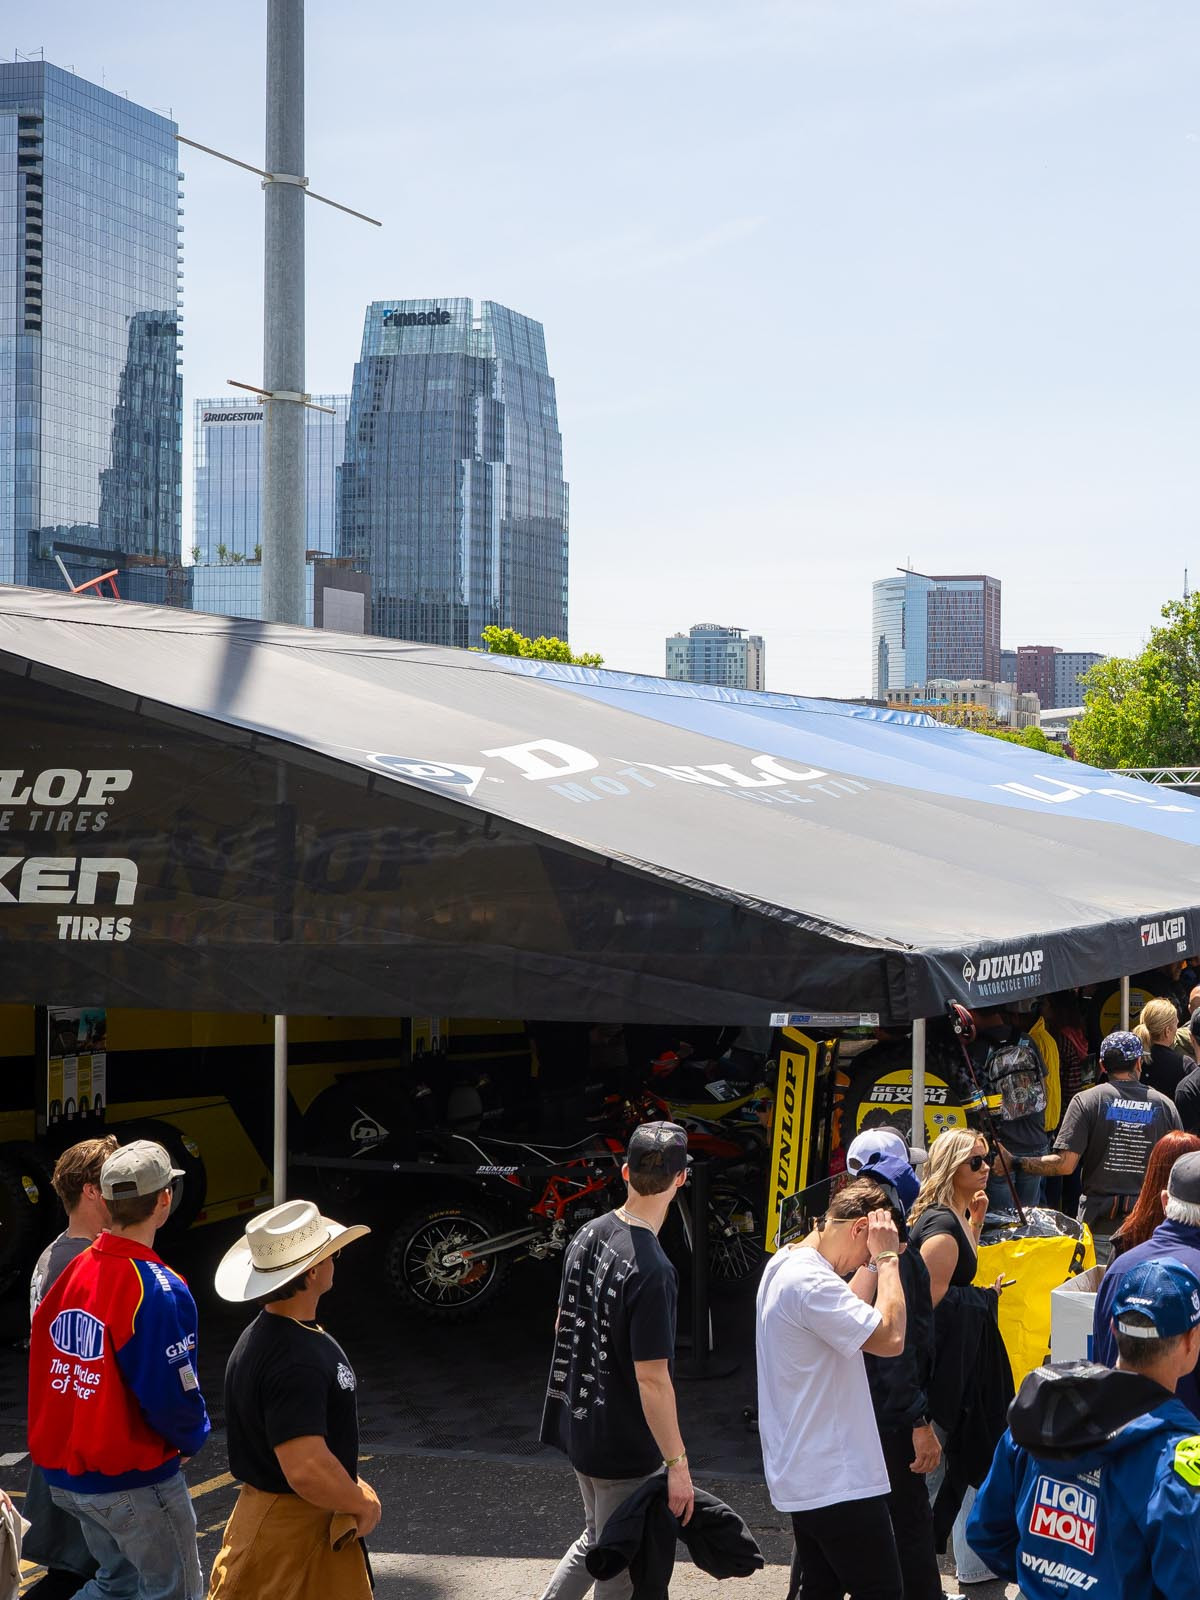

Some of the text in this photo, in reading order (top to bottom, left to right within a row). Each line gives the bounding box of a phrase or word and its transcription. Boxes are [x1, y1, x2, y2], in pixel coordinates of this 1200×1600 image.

[383, 307, 451, 327] Pinnacle
[29, 811, 109, 832] TIRES
[56, 915, 132, 942] TIRES
[1140, 916, 1186, 947] FALKEN
[976, 949, 1044, 982] DUNLOP
[978, 973, 1041, 997] MOTORCYCLE TIRES
[873, 1086, 948, 1095] GEOAX
[1113, 1098, 1152, 1111] HAIDEN
[49, 1359, 70, 1375] The
[51, 1375, 71, 1394] of
[1040, 1480, 1095, 1523] LIQUI
[1034, 1507, 1094, 1550] MOLY
[1022, 1551, 1099, 1591] DYNAVOLT
